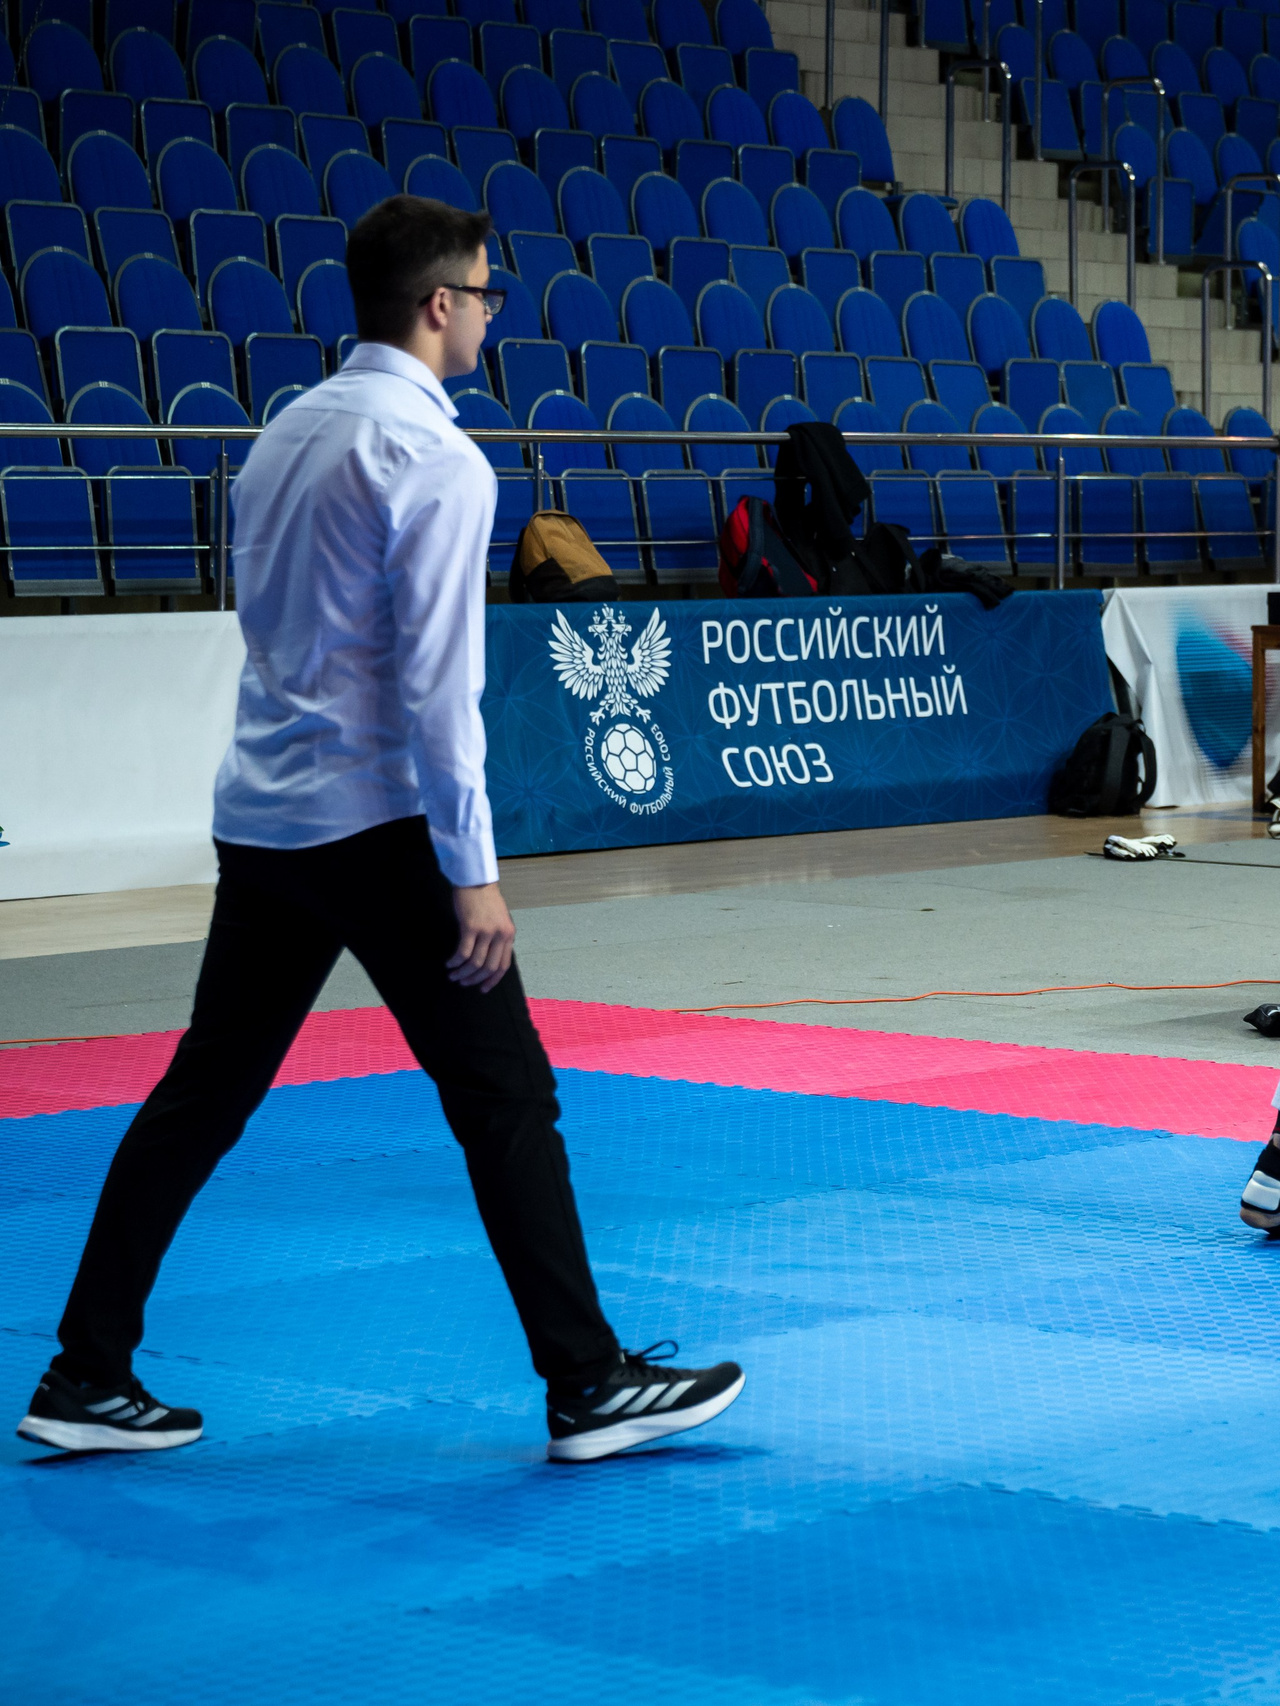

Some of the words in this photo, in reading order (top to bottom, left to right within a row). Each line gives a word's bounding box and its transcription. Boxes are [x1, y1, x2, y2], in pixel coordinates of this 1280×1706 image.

[702, 605, 946, 664] РОССИЙСКИЙ
[707, 665, 968, 729] ФУТБОЛЬНЫЙ
[585, 727, 627, 808] РОССИЙСКИЙ
[650, 724, 671, 762] СОЮЗ
[721, 743, 834, 788] СОЮЗ
[630, 766, 674, 815] ФУТБОЛЬНЫЙ
